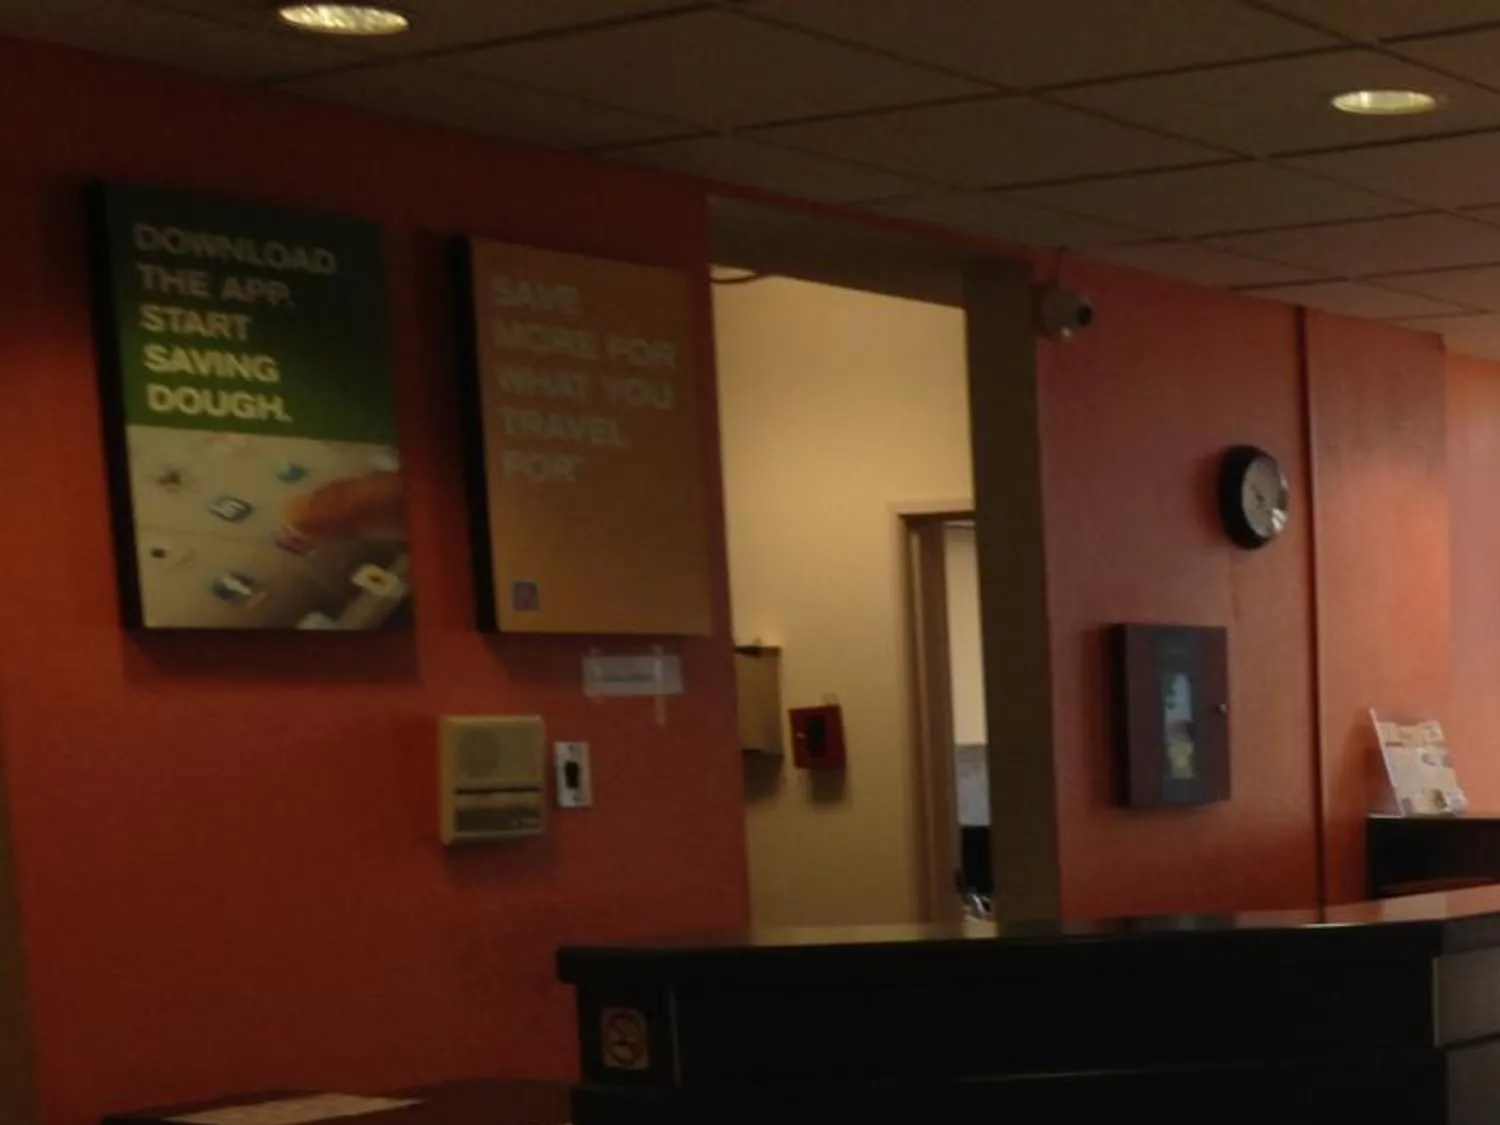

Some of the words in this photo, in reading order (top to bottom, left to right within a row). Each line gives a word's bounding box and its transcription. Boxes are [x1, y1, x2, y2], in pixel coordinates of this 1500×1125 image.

[134, 224, 337, 274] DOWNLOAD
[135, 261, 210, 297] THE
[221, 276, 295, 309] APP.
[139, 304, 252, 341] START
[144, 344, 280, 381] SAVING
[495, 322, 598, 359] MORE
[608, 335, 677, 368] FOR
[148, 384, 292, 422] DOUGH.
[498, 364, 586, 400] WHAT
[601, 375, 674, 410] YOU
[500, 408, 628, 447] TRAVEL
